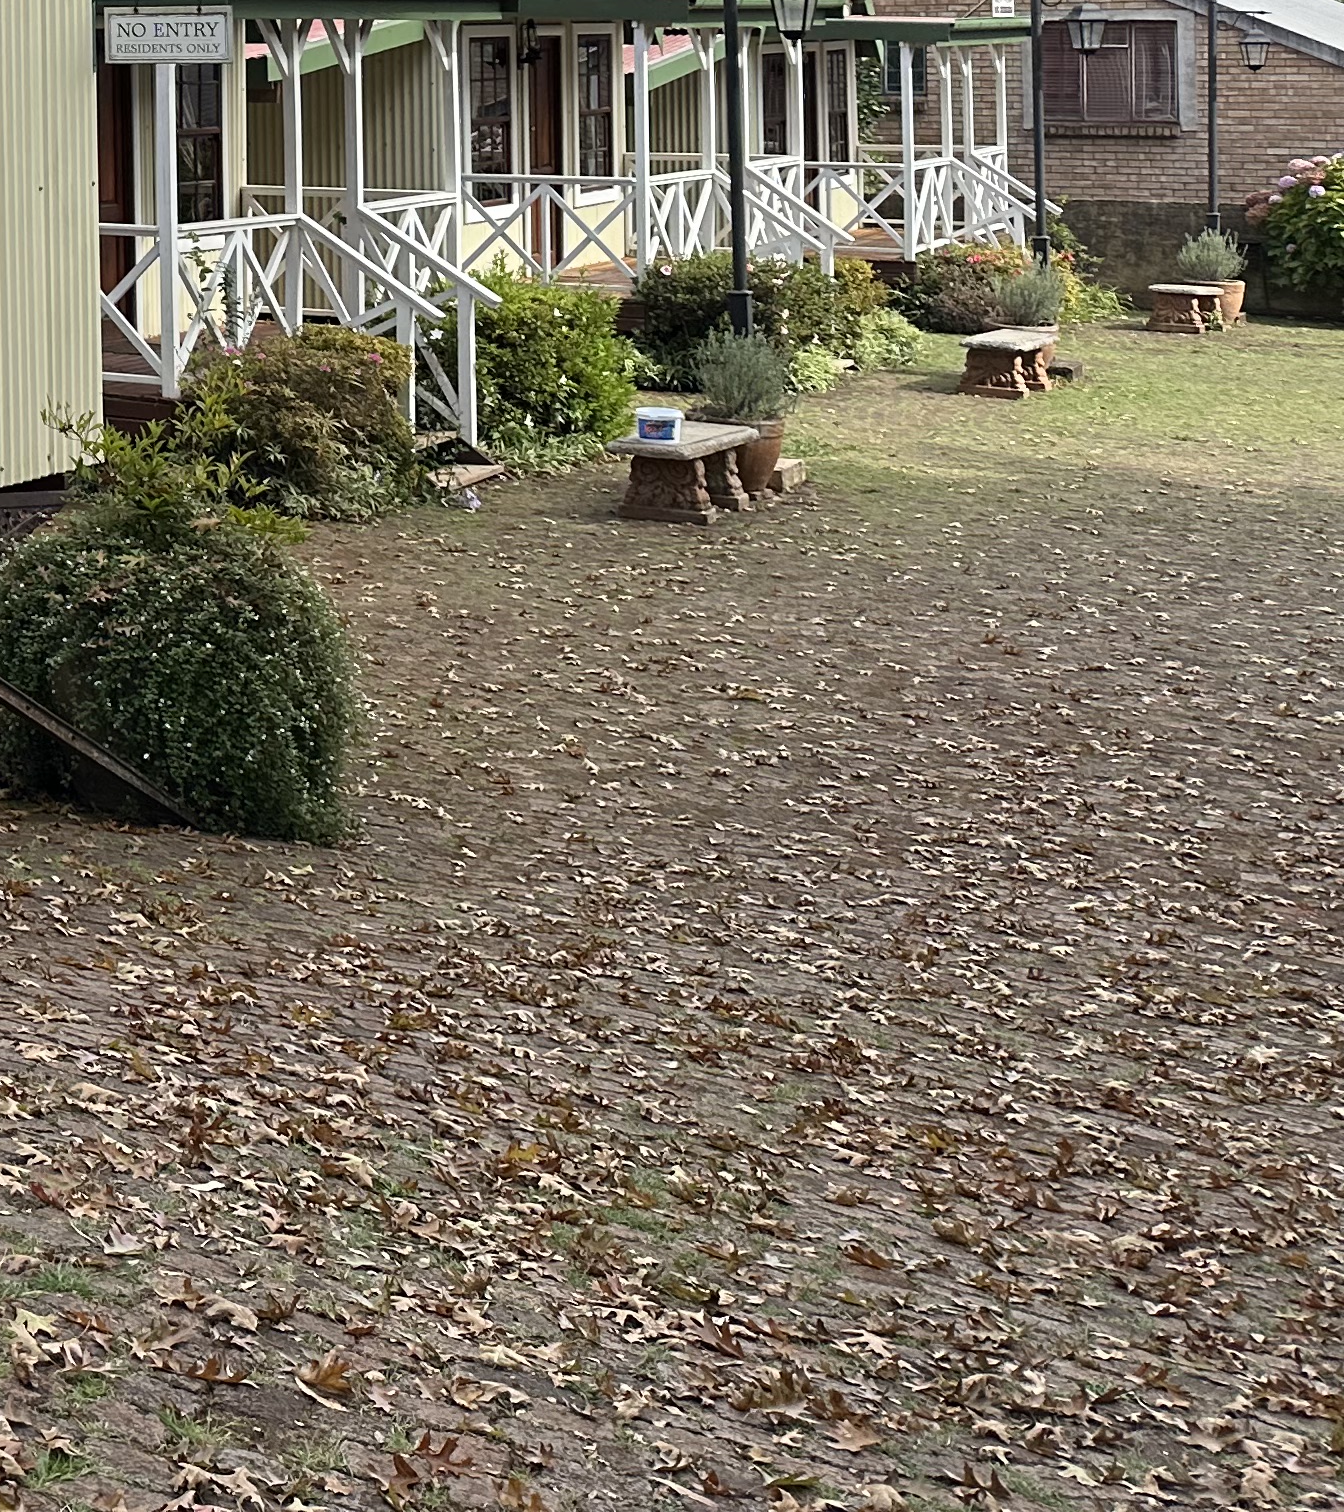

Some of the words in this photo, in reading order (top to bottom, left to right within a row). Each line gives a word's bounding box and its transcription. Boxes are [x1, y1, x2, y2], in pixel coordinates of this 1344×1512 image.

[117, 23, 146, 38] NO
[153, 22, 219, 38] ENTRY
[116, 43, 182, 53] RESIDENTS
[186, 43, 221, 54] ONLY
